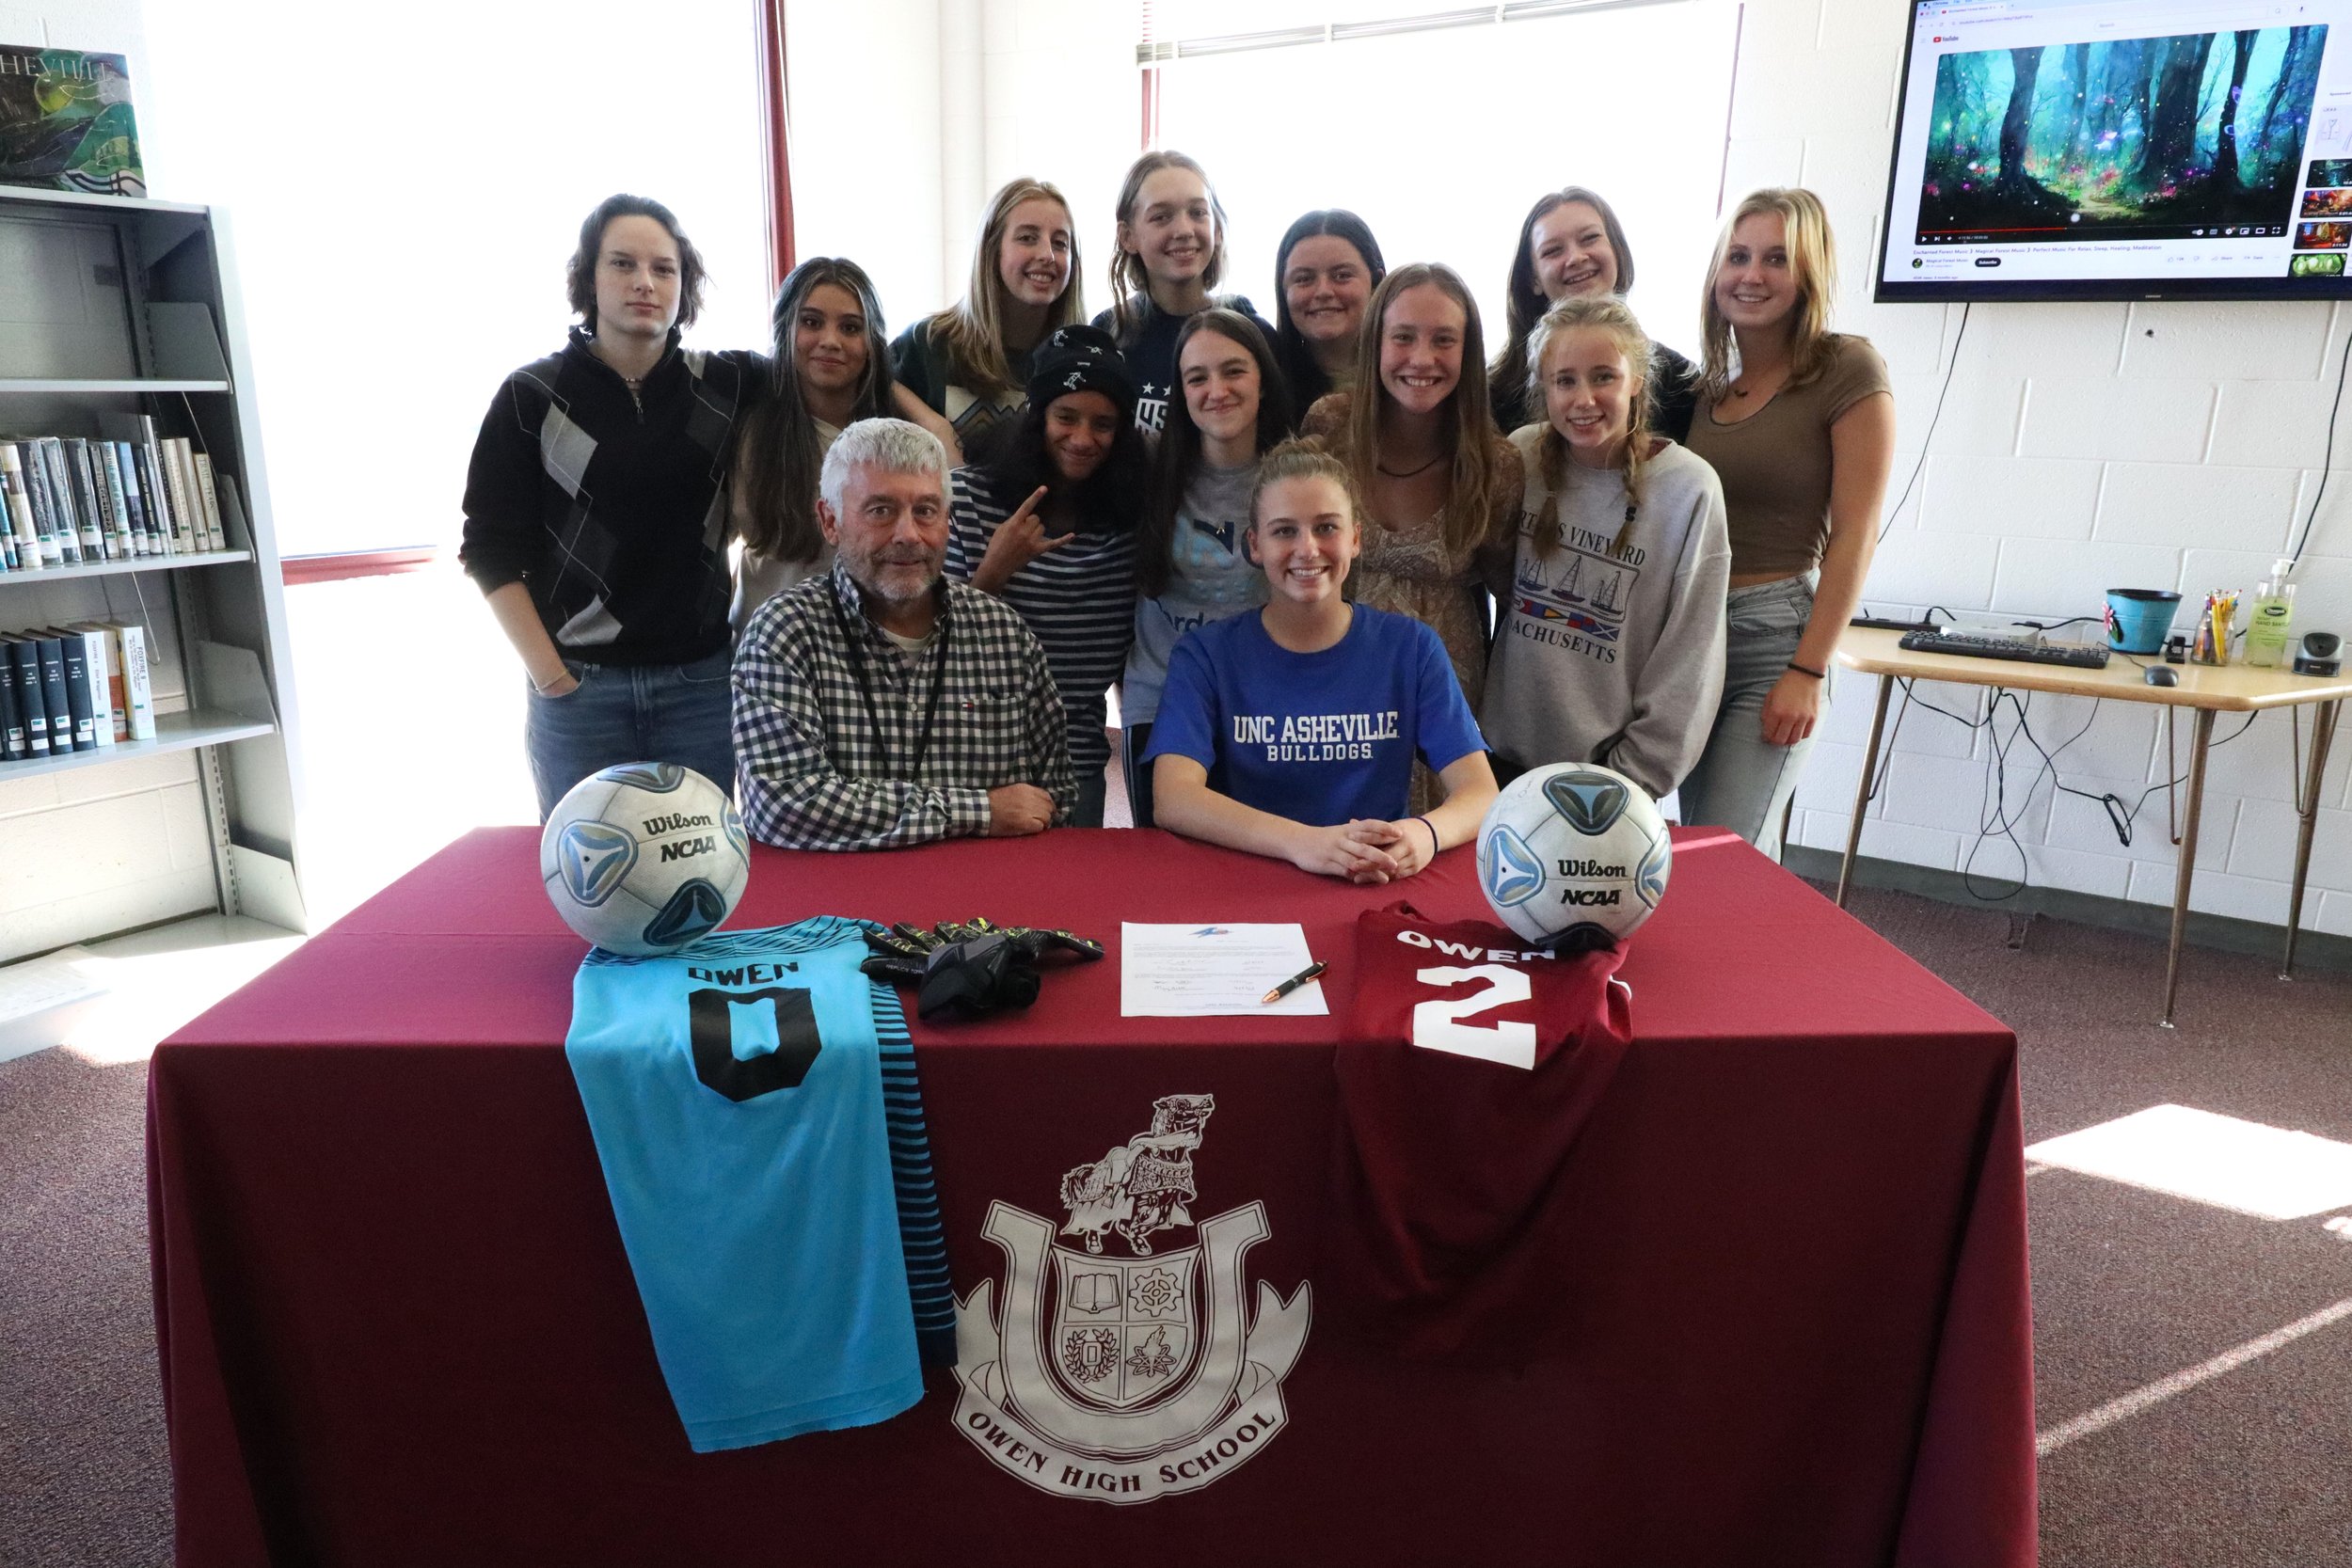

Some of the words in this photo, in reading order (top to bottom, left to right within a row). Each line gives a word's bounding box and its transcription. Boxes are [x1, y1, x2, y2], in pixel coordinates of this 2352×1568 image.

[0, 54, 113, 82] HEVILLE
[1507, 616, 1617, 664] ACHUSETTS
[136, 646, 146, 673] FOXFIRE
[1233, 716, 1276, 744] UNC
[1280, 711, 1400, 743] ASHEVILLE
[1267, 743, 1374, 762] BULLDOGS
[643, 813, 714, 836] Wilson
[660, 835, 717, 863] NCAA
[1558, 860, 1628, 877] Wilson
[1561, 889, 1622, 906] NCAA
[1396, 930, 1556, 963] OWEN
[688, 961, 800, 986] OWEN
[1413, 963, 1537, 1071] 2
[967, 1412, 1048, 1474] OWEN
[1059, 1465, 1141, 1494] HIGH
[1158, 1412, 1277, 1484] SCHOOL
